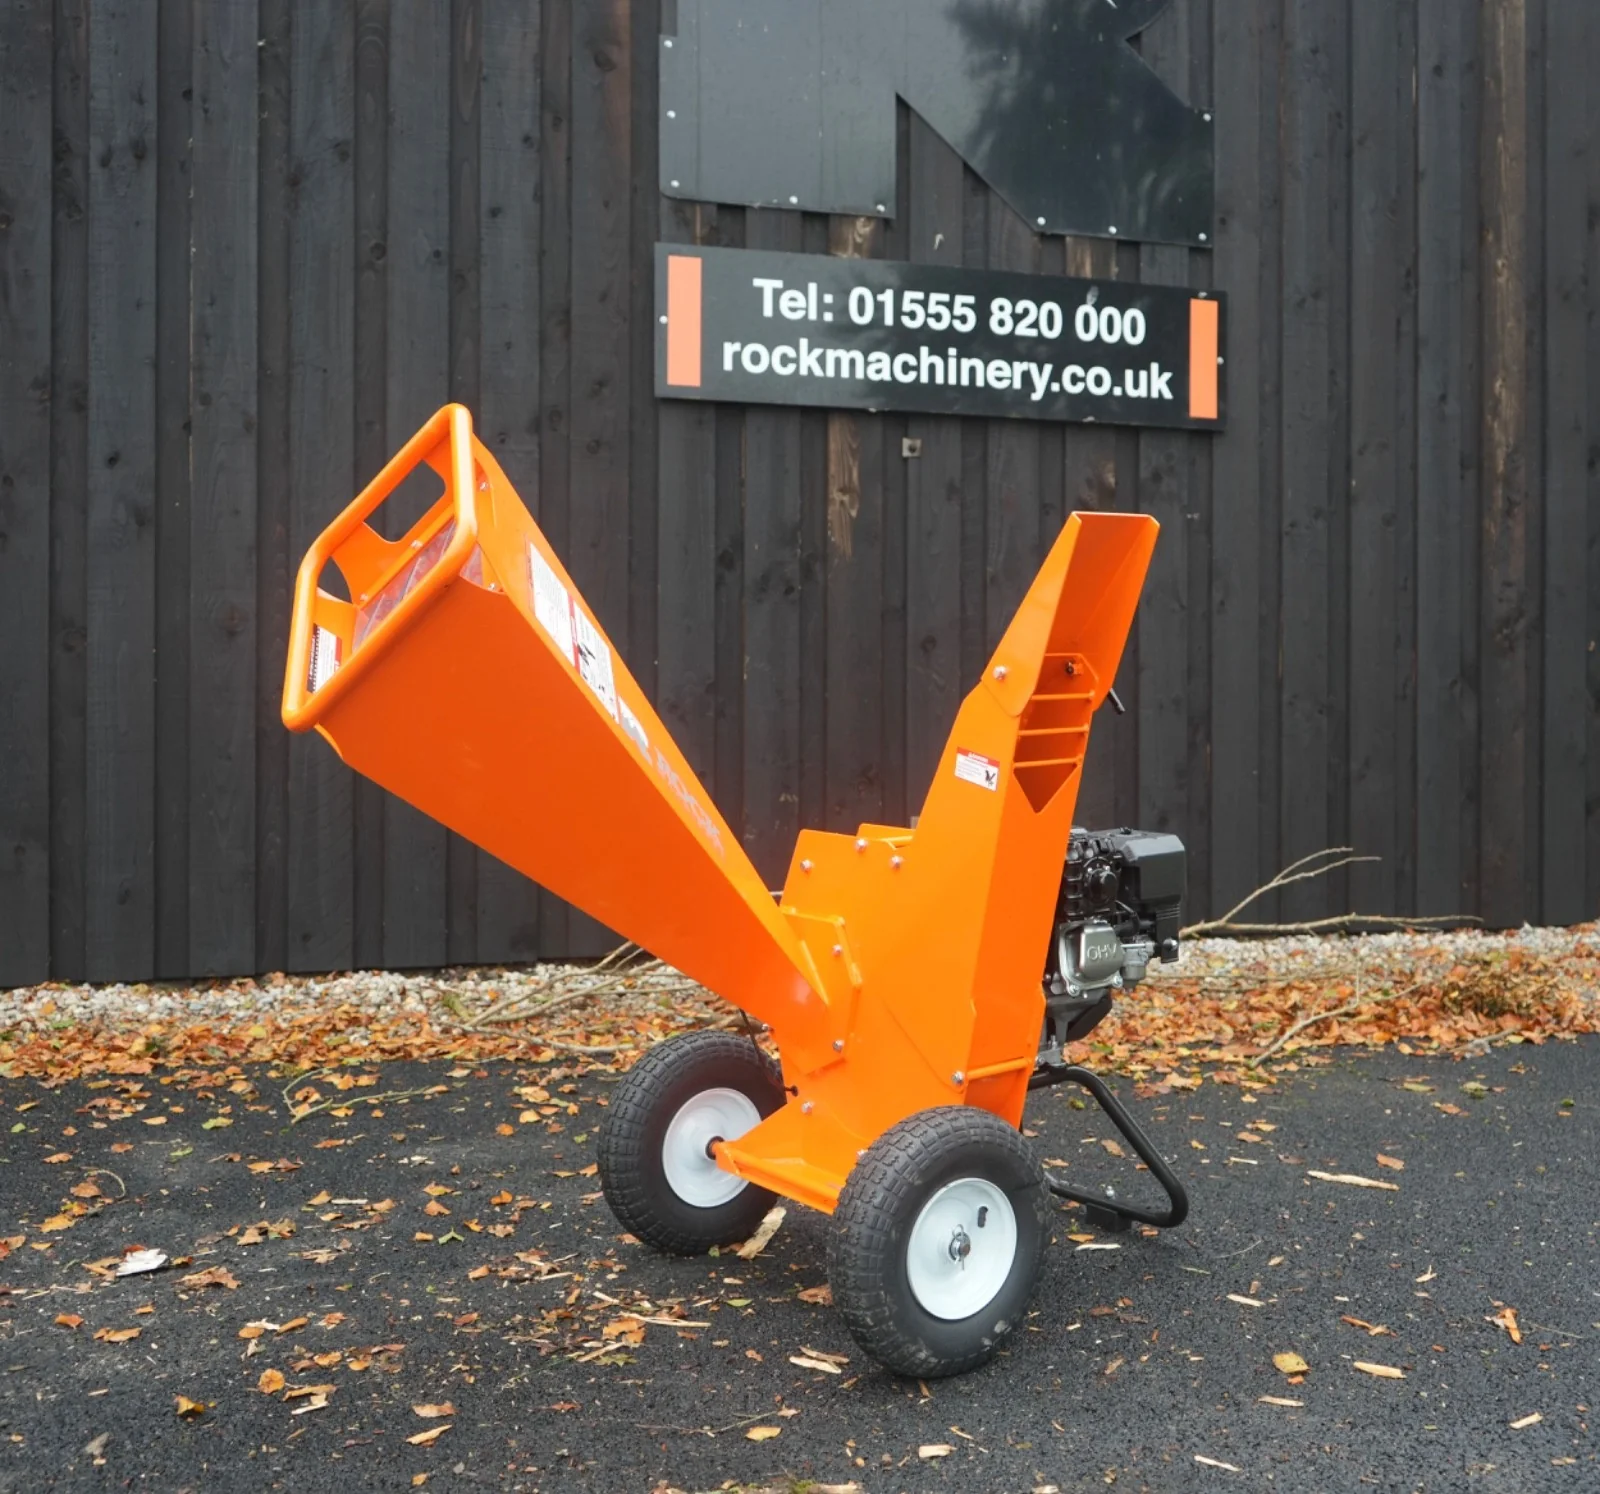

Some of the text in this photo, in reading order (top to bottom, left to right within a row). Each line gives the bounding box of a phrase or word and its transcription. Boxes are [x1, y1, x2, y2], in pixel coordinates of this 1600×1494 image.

[752, 277, 1146, 345] Tel: 01555 820 000
[723, 337, 1173, 401] rockmachinery.co.uk
[1086, 943, 1117, 960] OHV
